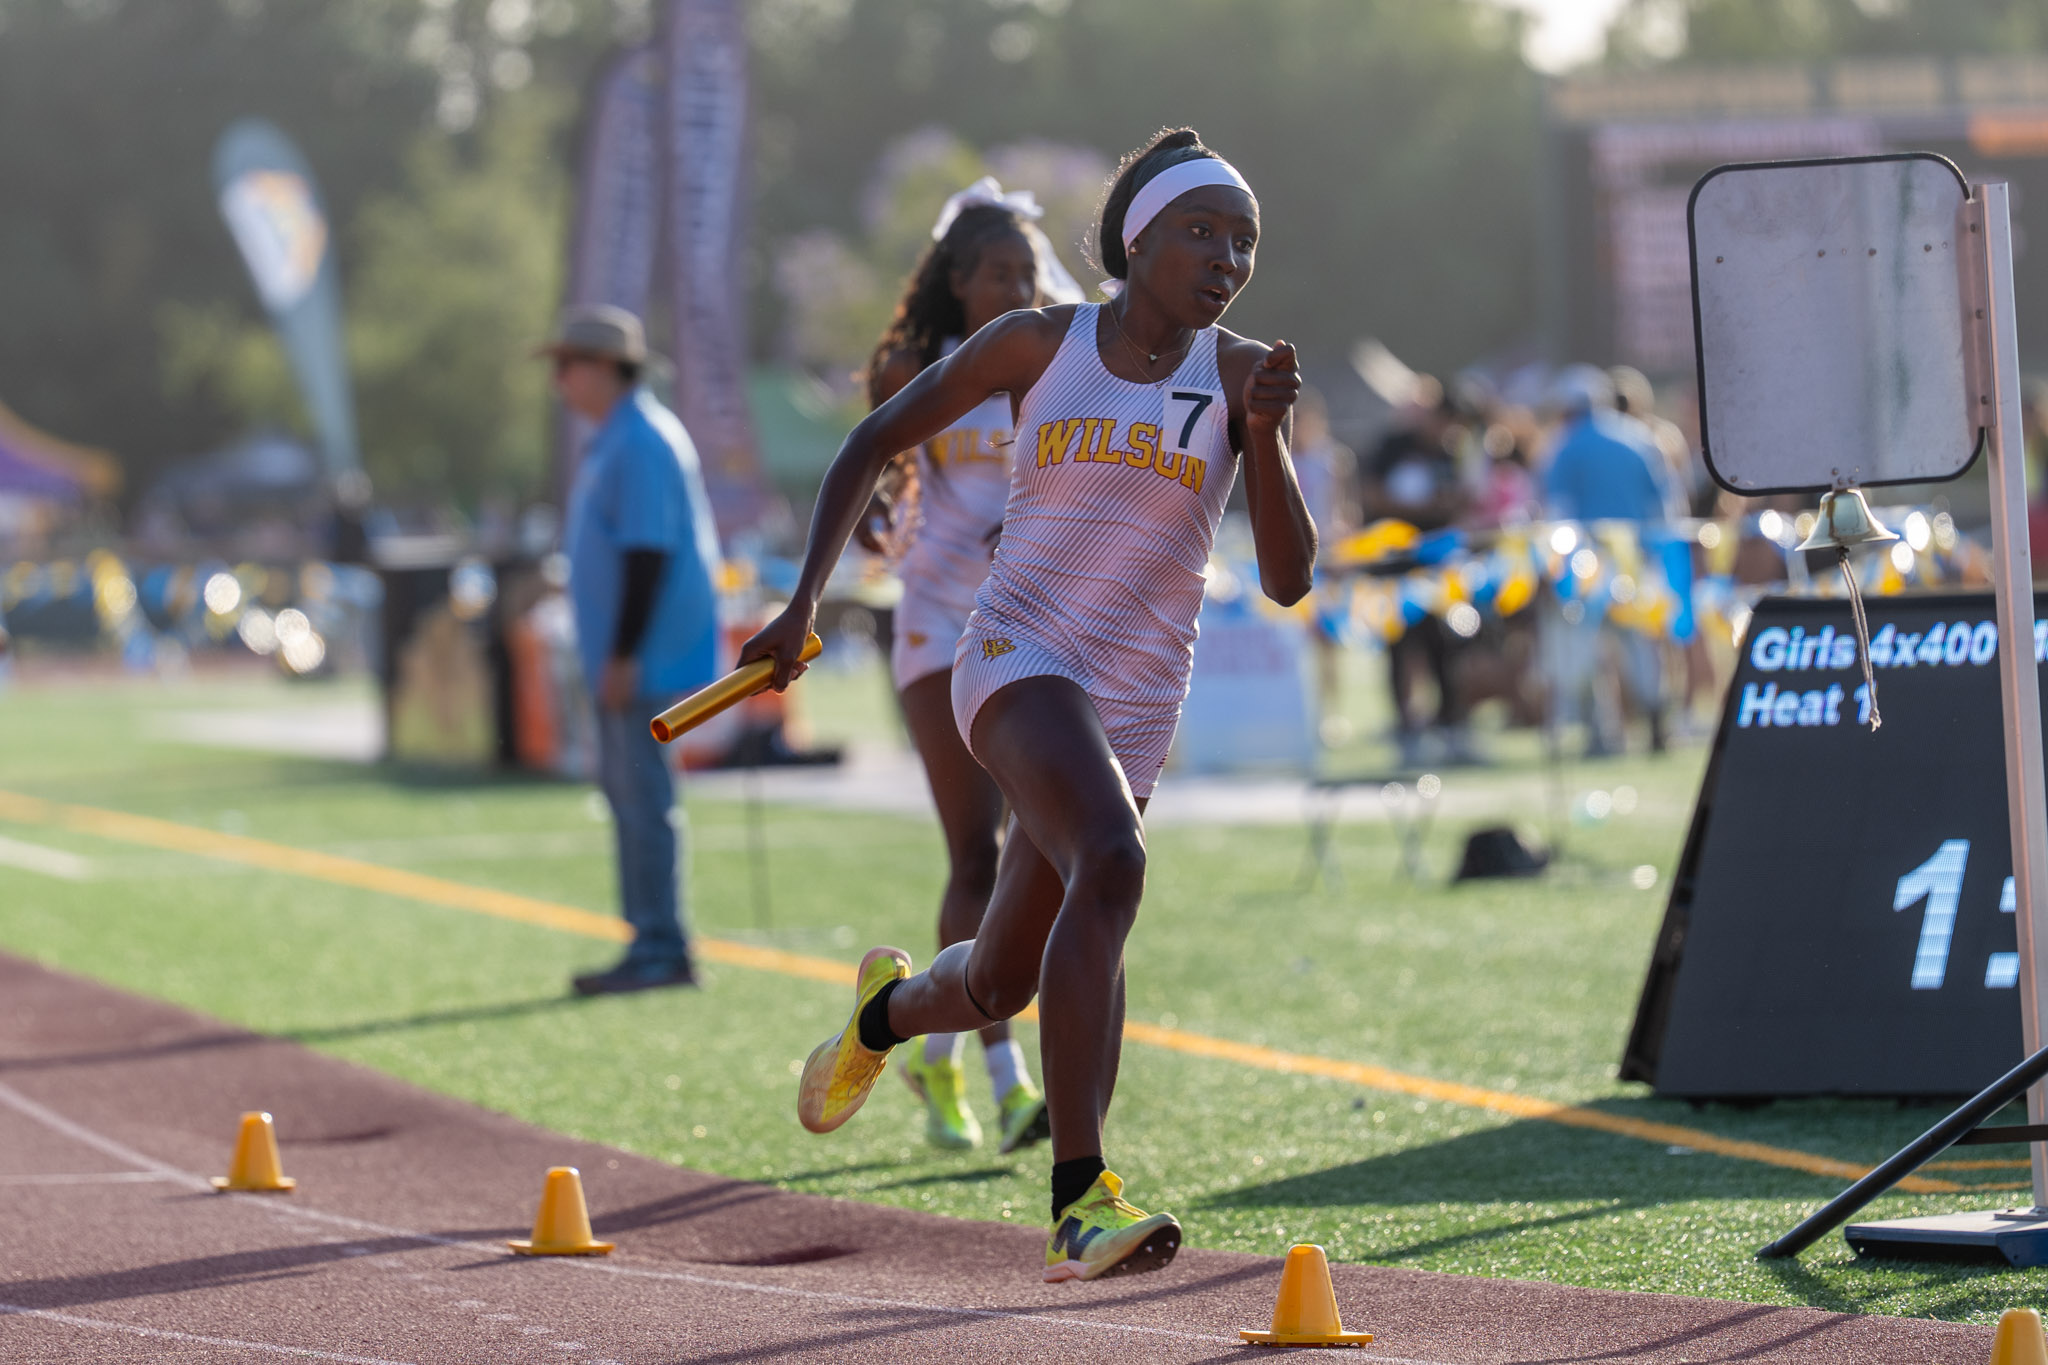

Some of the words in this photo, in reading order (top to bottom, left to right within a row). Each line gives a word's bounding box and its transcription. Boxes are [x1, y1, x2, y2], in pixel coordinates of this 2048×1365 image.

[1172, 391, 1213, 449] 7
[1750, 624, 1858, 672] Girls
[1866, 619, 1998, 668] 4x400
[1736, 681, 1845, 728] Heat
